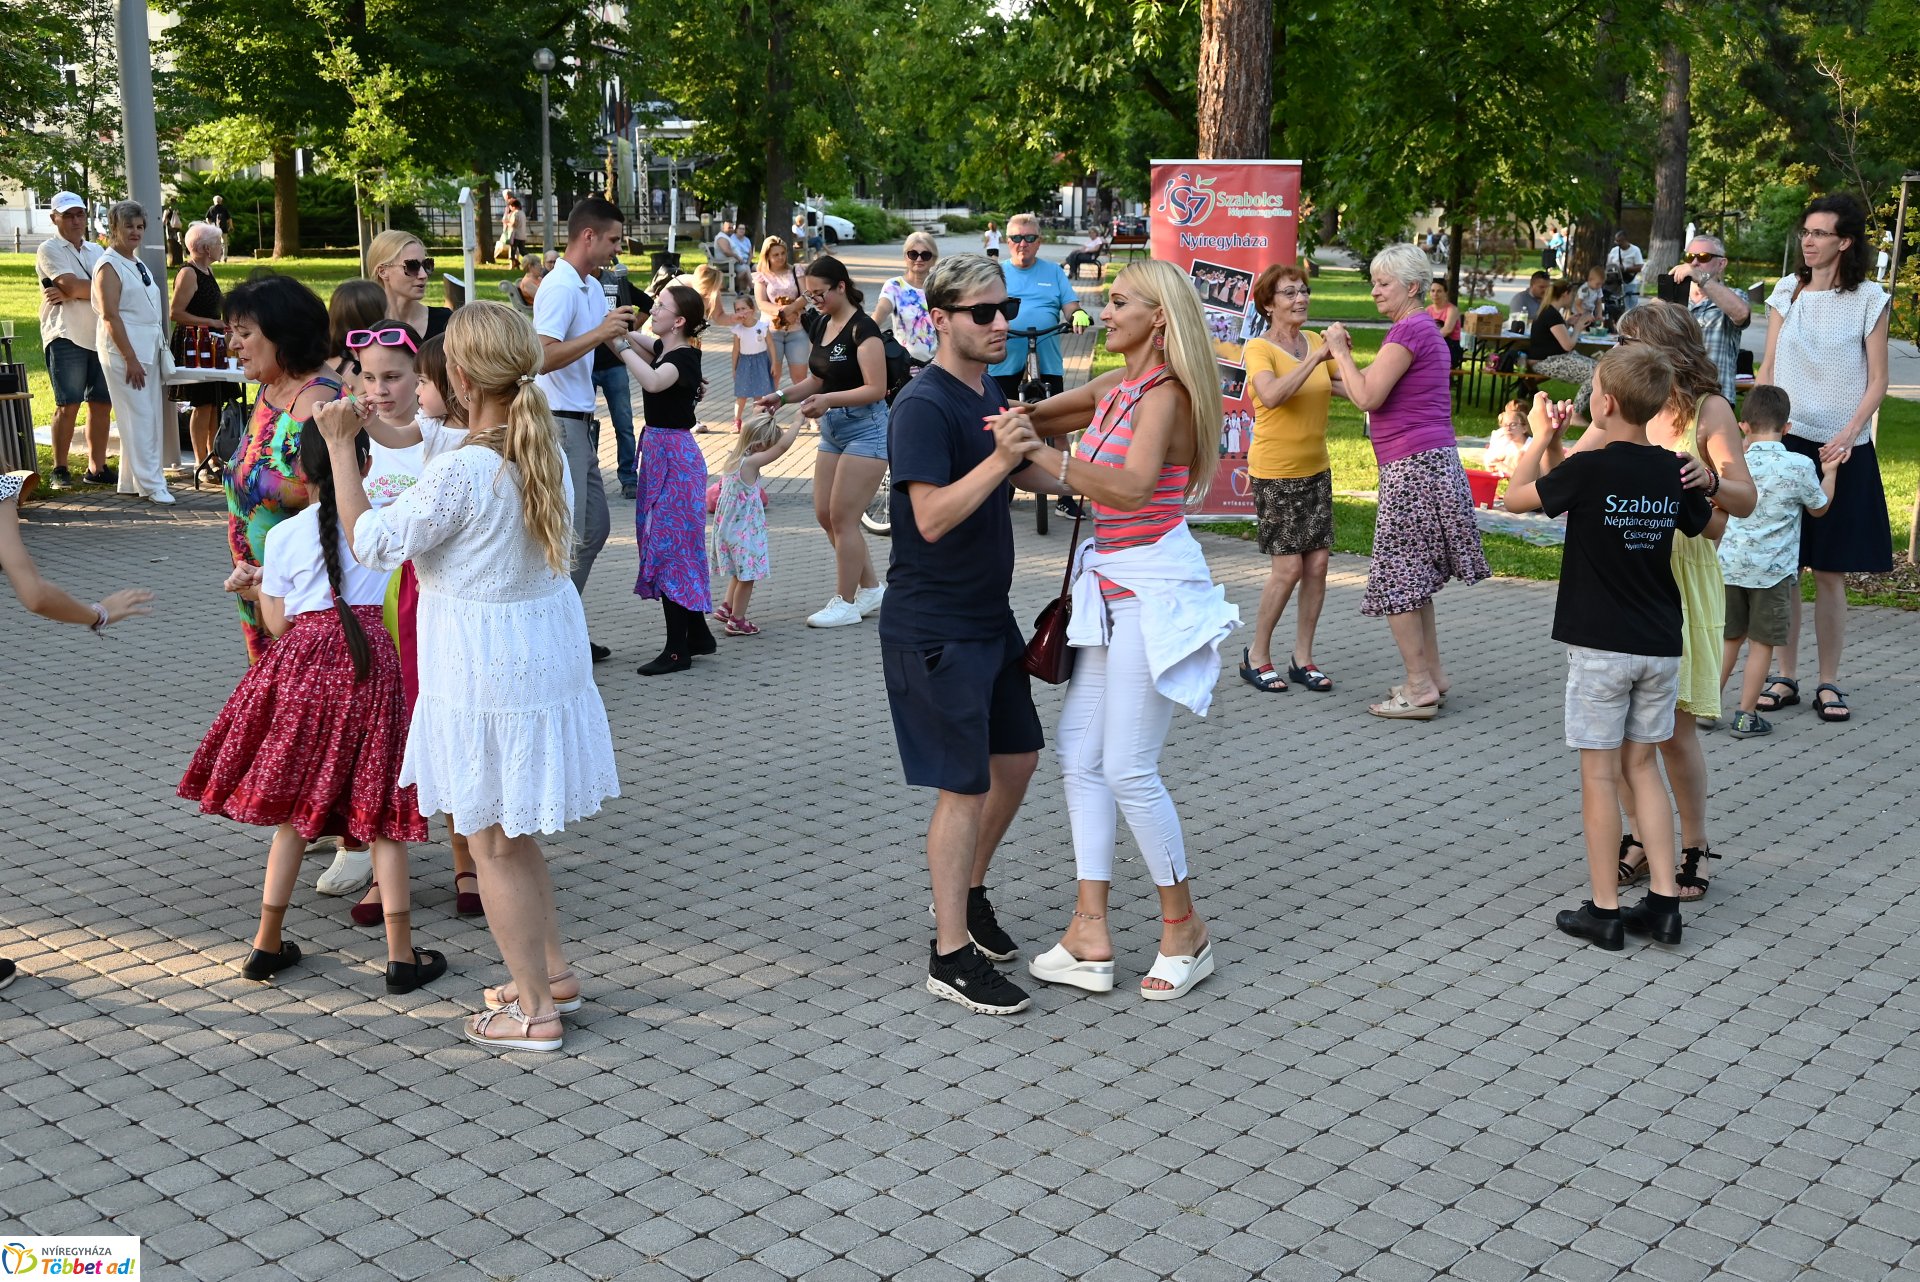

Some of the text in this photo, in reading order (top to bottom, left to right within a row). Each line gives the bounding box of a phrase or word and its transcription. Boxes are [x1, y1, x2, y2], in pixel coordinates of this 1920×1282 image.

[1217, 191, 1283, 207] Szabolcs
[1180, 232, 1268, 251] Nyíregyháza
[1604, 515, 1675, 529] Néptáncegyütt
